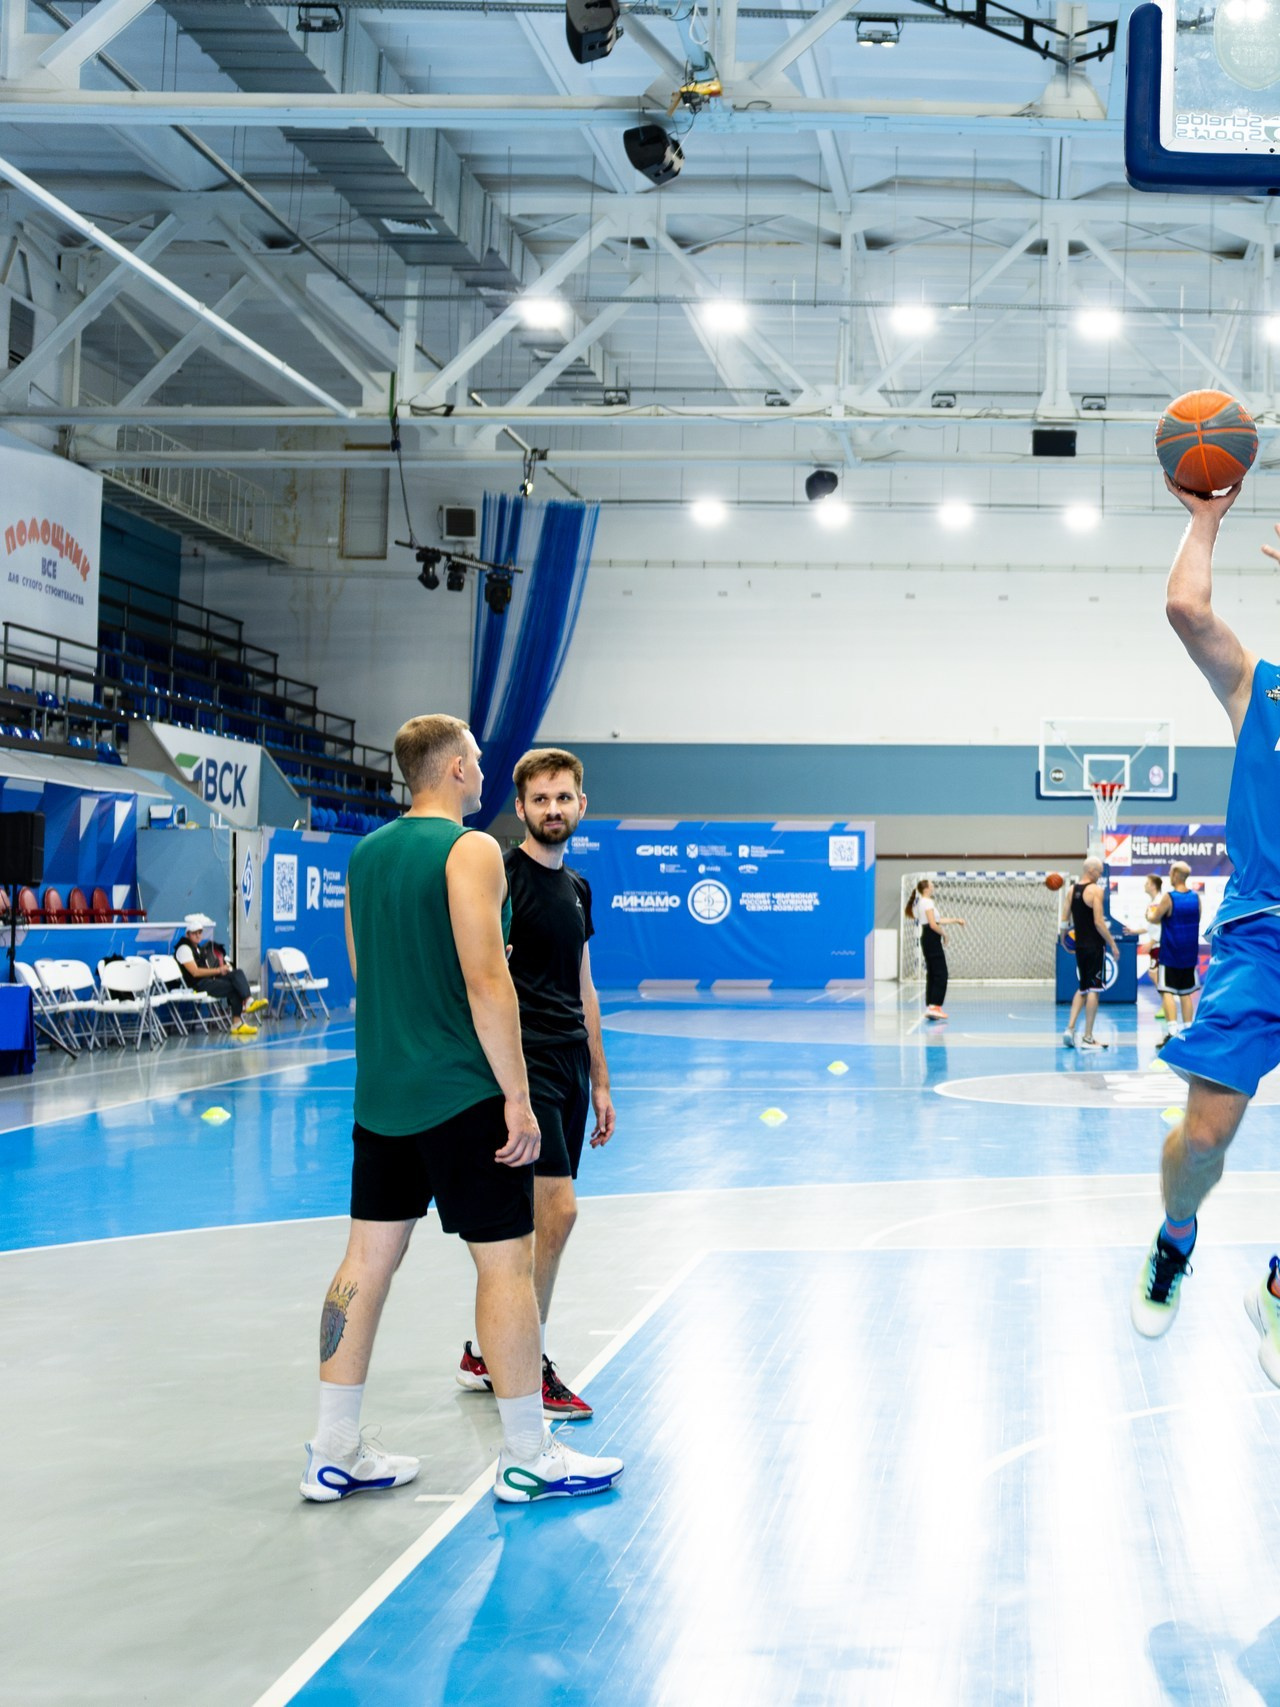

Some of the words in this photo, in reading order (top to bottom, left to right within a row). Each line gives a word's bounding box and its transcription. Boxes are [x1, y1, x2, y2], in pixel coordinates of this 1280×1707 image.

[4, 516, 91, 582] ПОМОЩНИК
[22, 576, 42, 592] СУХОГО
[45, 583, 84, 605] СТРОИТЕЛЬСТВА
[204, 757, 248, 810] ВСК
[1131, 843, 1214, 856] ЧЕМПИОНАТ
[611, 895, 681, 909] ДИНАМО
